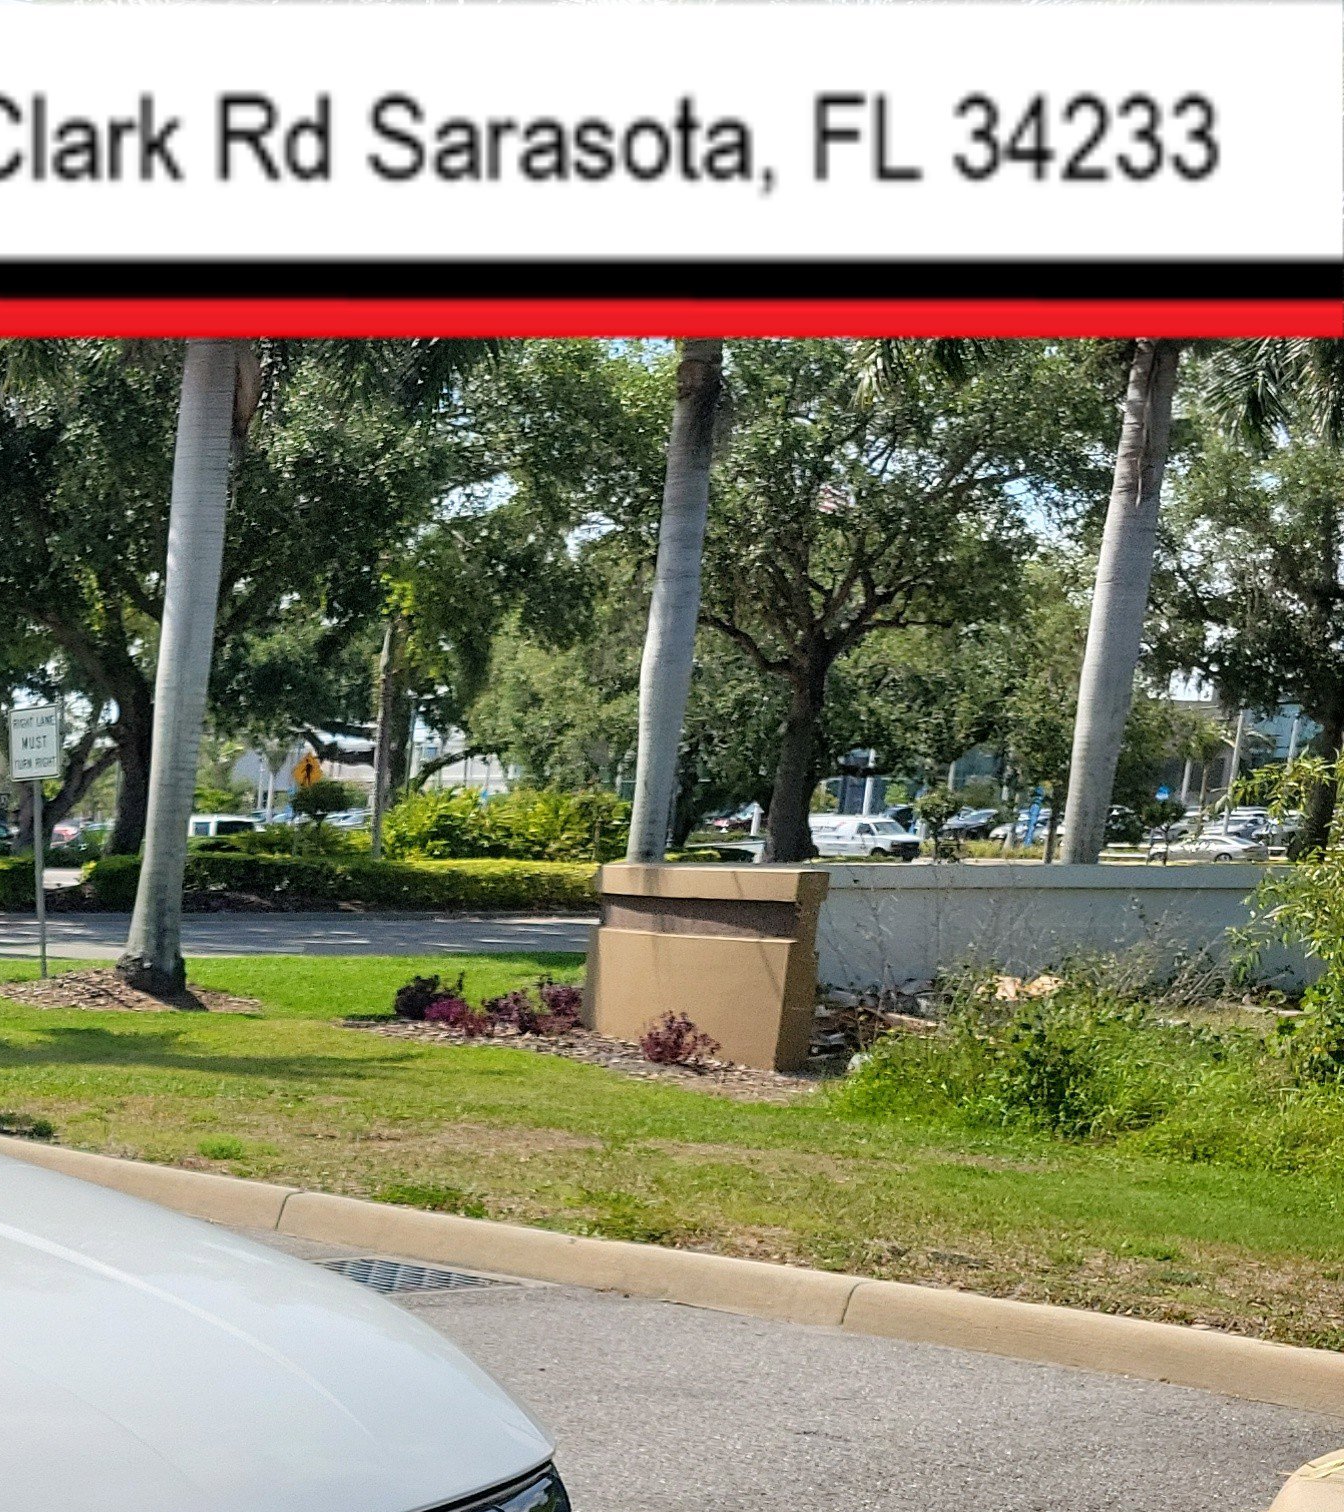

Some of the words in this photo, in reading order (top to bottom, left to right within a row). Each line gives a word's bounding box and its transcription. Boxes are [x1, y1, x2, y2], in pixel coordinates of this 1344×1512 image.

[13, 717, 34, 728] RIGHT
[36, 715, 56, 727] LANE
[22, 735, 47, 749] MUST
[14, 758, 32, 770] TURN
[34, 756, 56, 768] RIGHT
